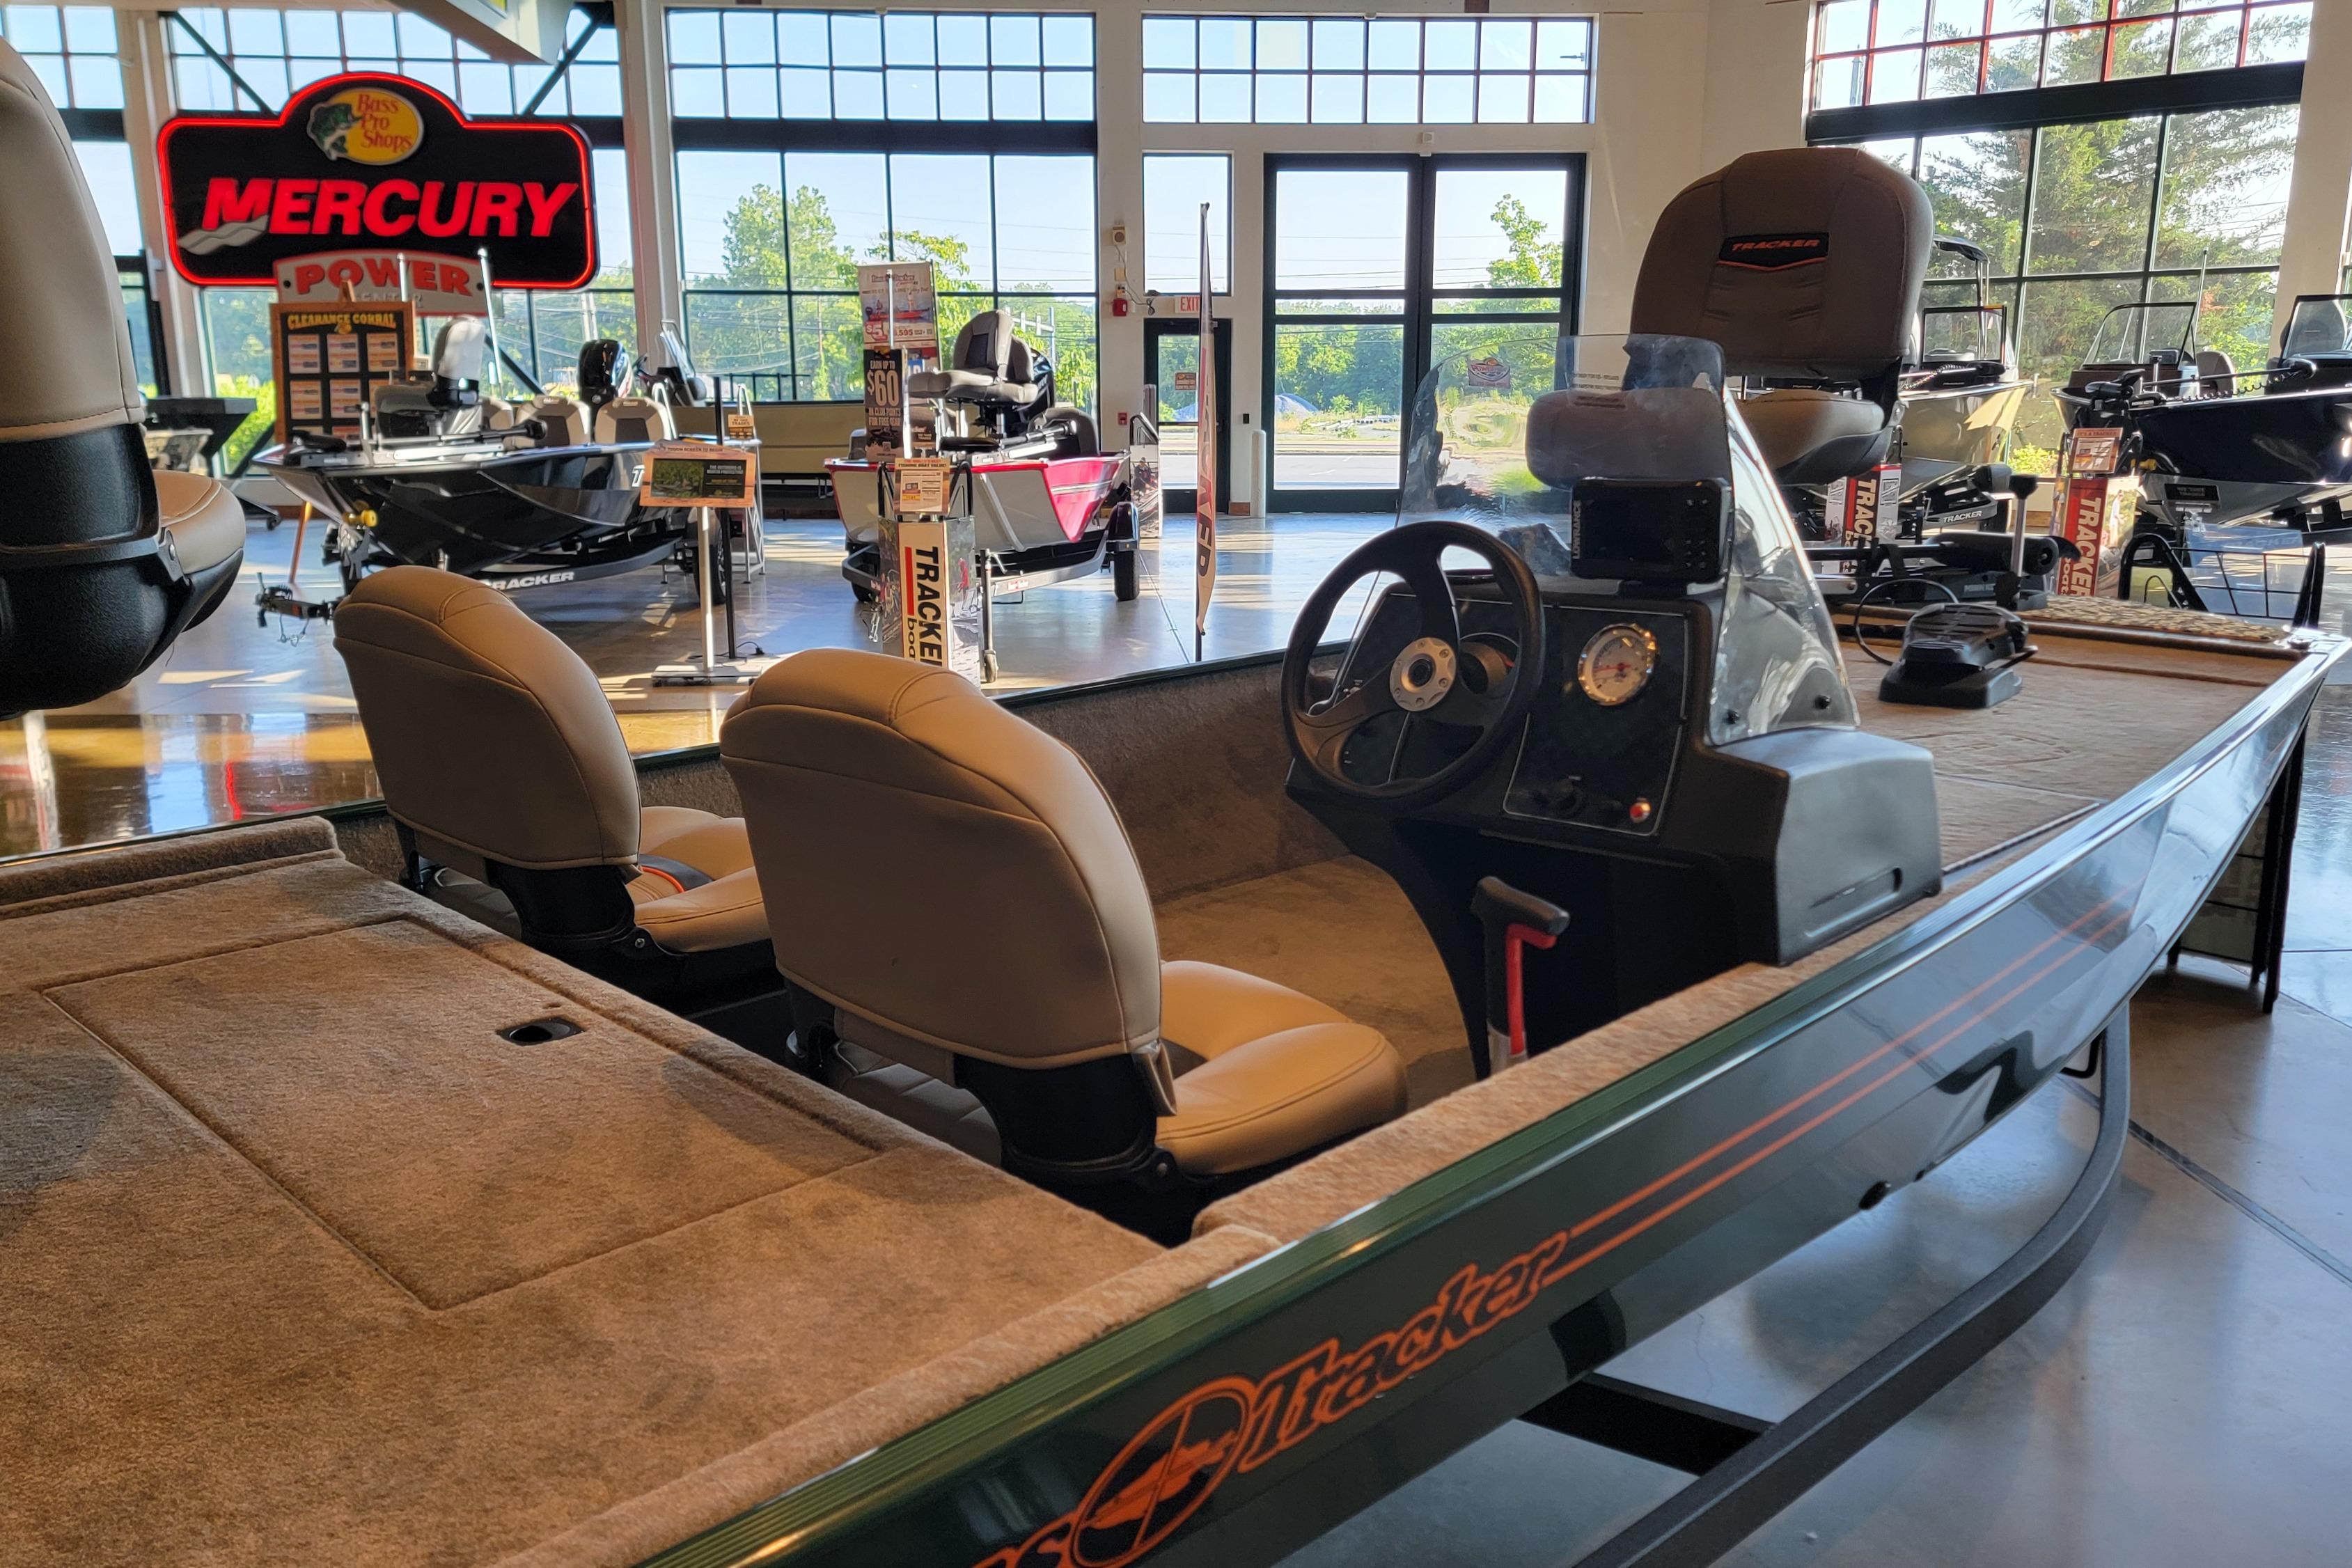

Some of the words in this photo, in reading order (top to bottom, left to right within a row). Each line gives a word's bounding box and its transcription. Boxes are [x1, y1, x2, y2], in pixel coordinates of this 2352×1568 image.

[356, 94, 399, 113] Bass
[361, 113, 390, 130] Pro
[361, 131, 413, 153] Shops
[201, 178, 579, 237] MERCURY
[1732, 239, 1821, 251] TRACKER
[295, 258, 473, 297] POWER
[1180, 297, 1200, 312] EXIT
[288, 313, 351, 331] CLEARANCE
[352, 313, 397, 329] CORRAL
[870, 360, 882, 369] EARN
[882, 360, 888, 369] UP
[889, 360, 896, 369] TO
[867, 370, 900, 407] $60
[1853, 479, 1877, 548] TRACK
[1943, 510, 1983, 523] TRACKER
[1572, 499, 1582, 559] LOWRANCE
[1237, 1229, 1571, 1473] Tracker
